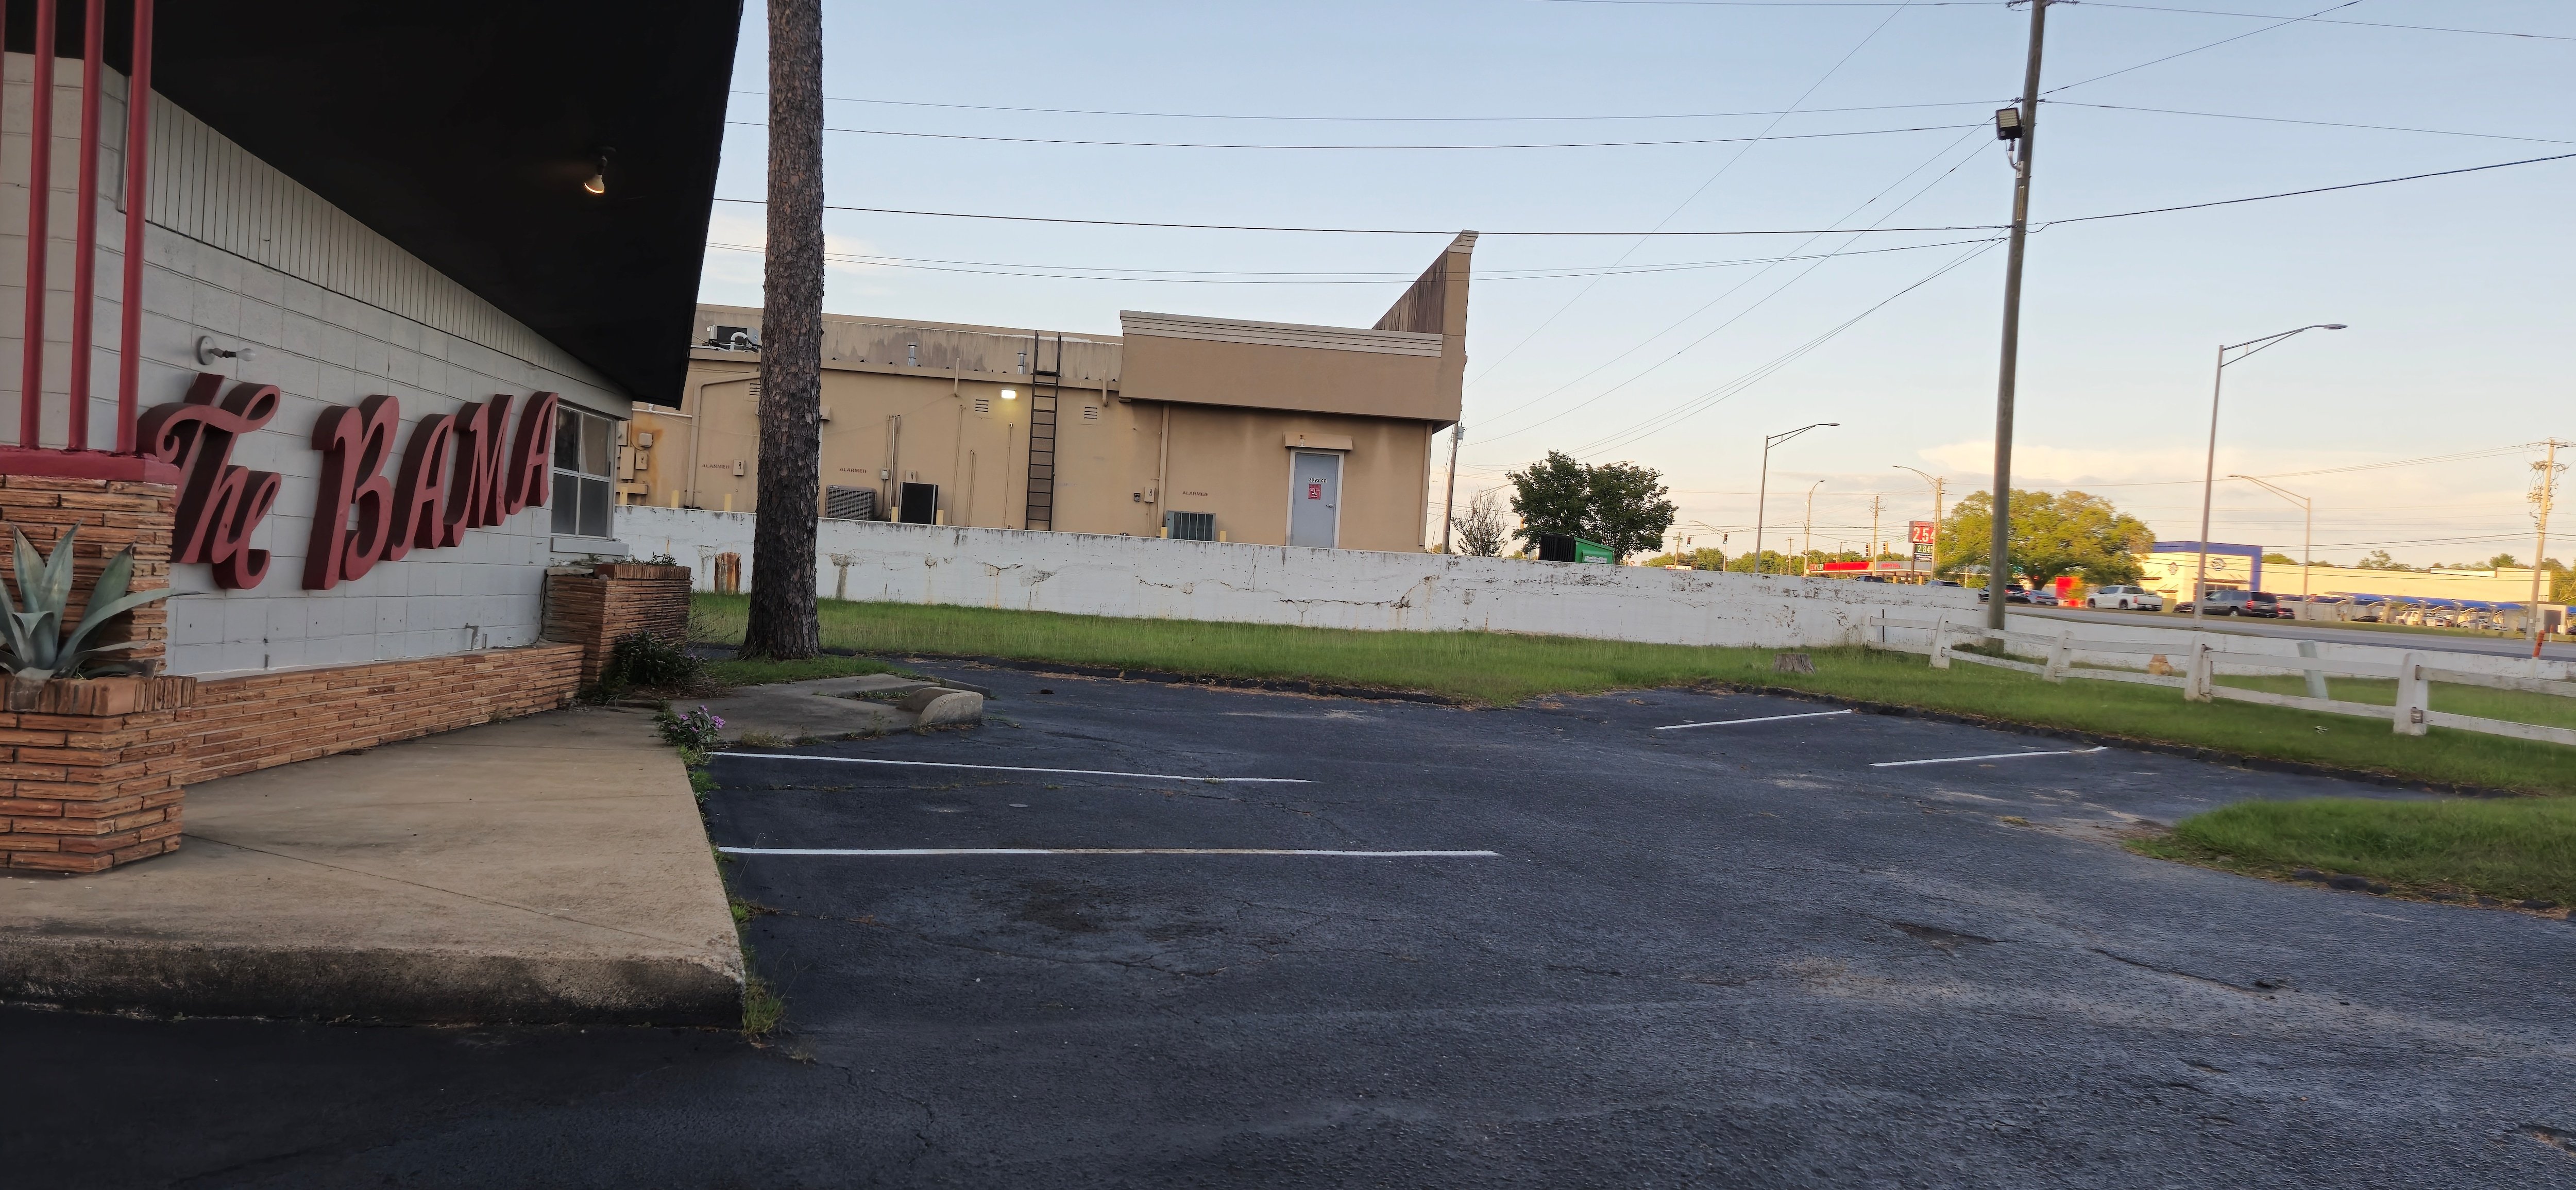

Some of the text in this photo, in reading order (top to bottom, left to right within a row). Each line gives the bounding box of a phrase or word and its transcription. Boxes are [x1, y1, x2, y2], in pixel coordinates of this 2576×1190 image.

[137, 373, 558, 590] The BAMA
[1917, 545, 1930, 553] 2.84
